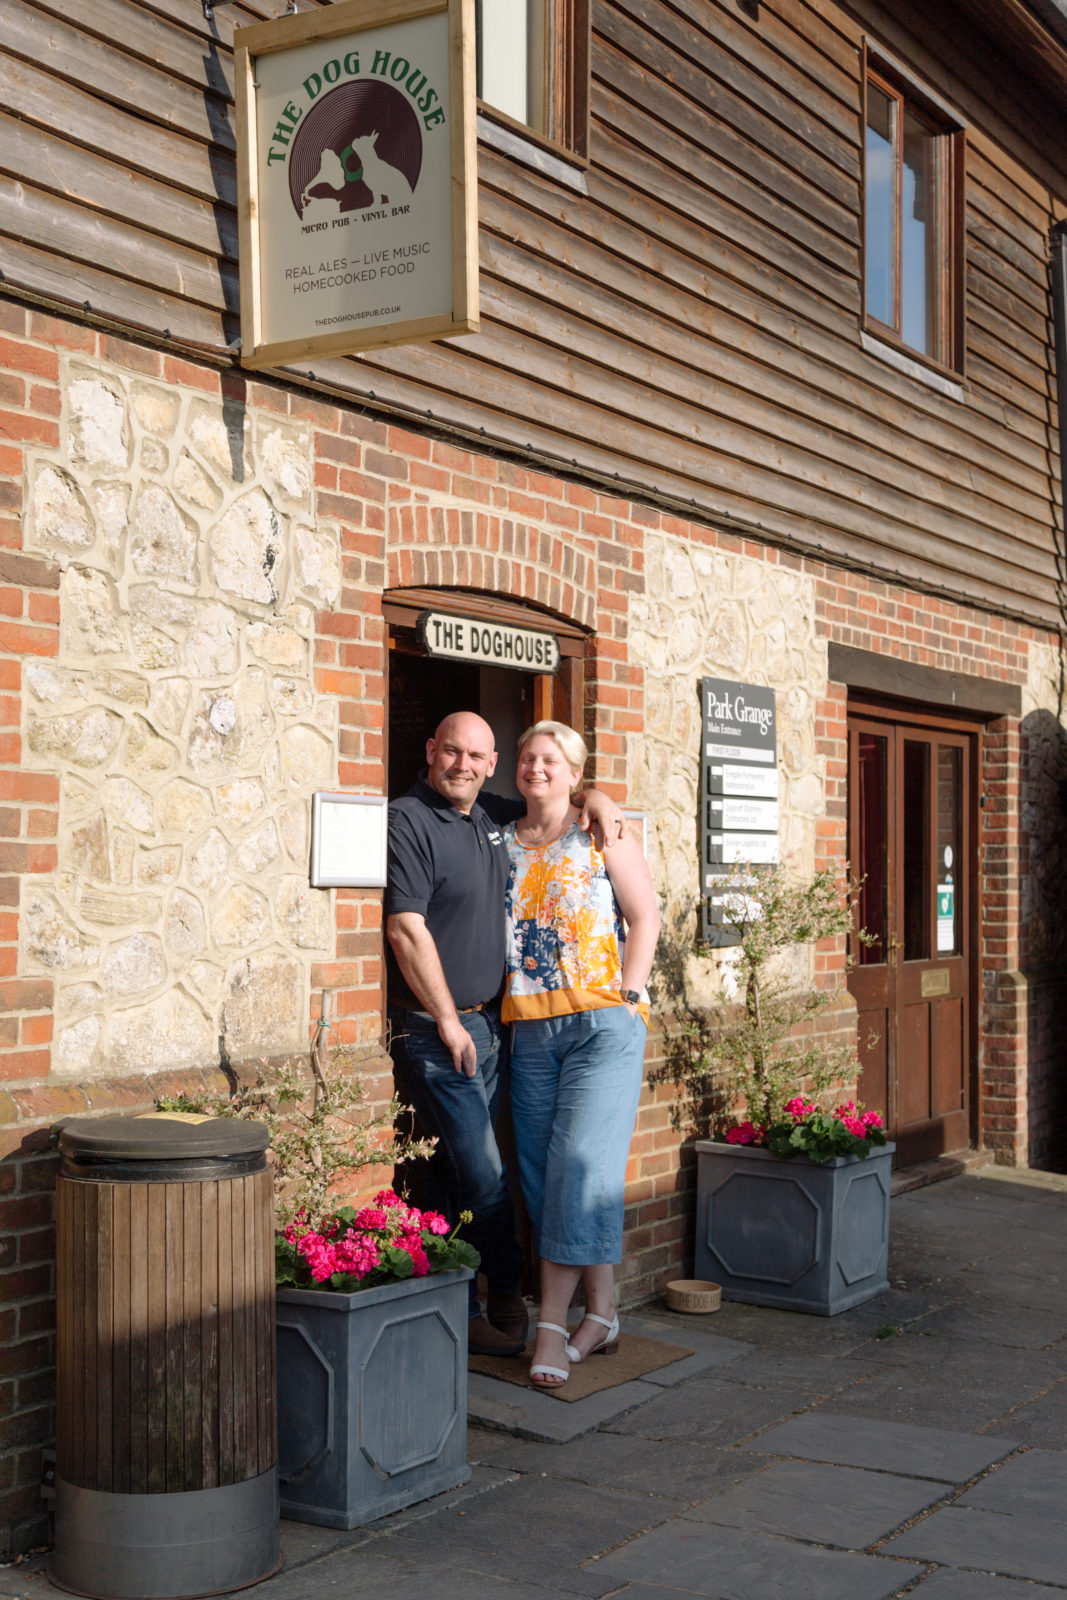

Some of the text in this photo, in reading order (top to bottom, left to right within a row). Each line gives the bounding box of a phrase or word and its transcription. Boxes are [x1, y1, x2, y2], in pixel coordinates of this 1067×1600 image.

[267, 50, 446, 166] THE DOG HOUSE
[301, 222, 328, 234] MICRO
[332, 217, 350, 229] PUB
[361, 210, 387, 222] VINYL
[391, 205, 410, 217] BAR
[285, 265, 315, 280] REAL
[318, 258, 348, 273] ALES
[363, 250, 390, 265] LIVE
[393, 242, 431, 259] MUSIC
[293, 261, 415, 294] HOMECOOKED FOOD
[315, 305, 402, 326] THEDOGHOUSEPUB.CO.UK
[432, 620, 553, 666] THE DOGHOUSE
[707, 691, 773, 736] Park Grange
[707, 720, 742, 736] Main Entrance
[693, 1294, 708, 1309] DOG
